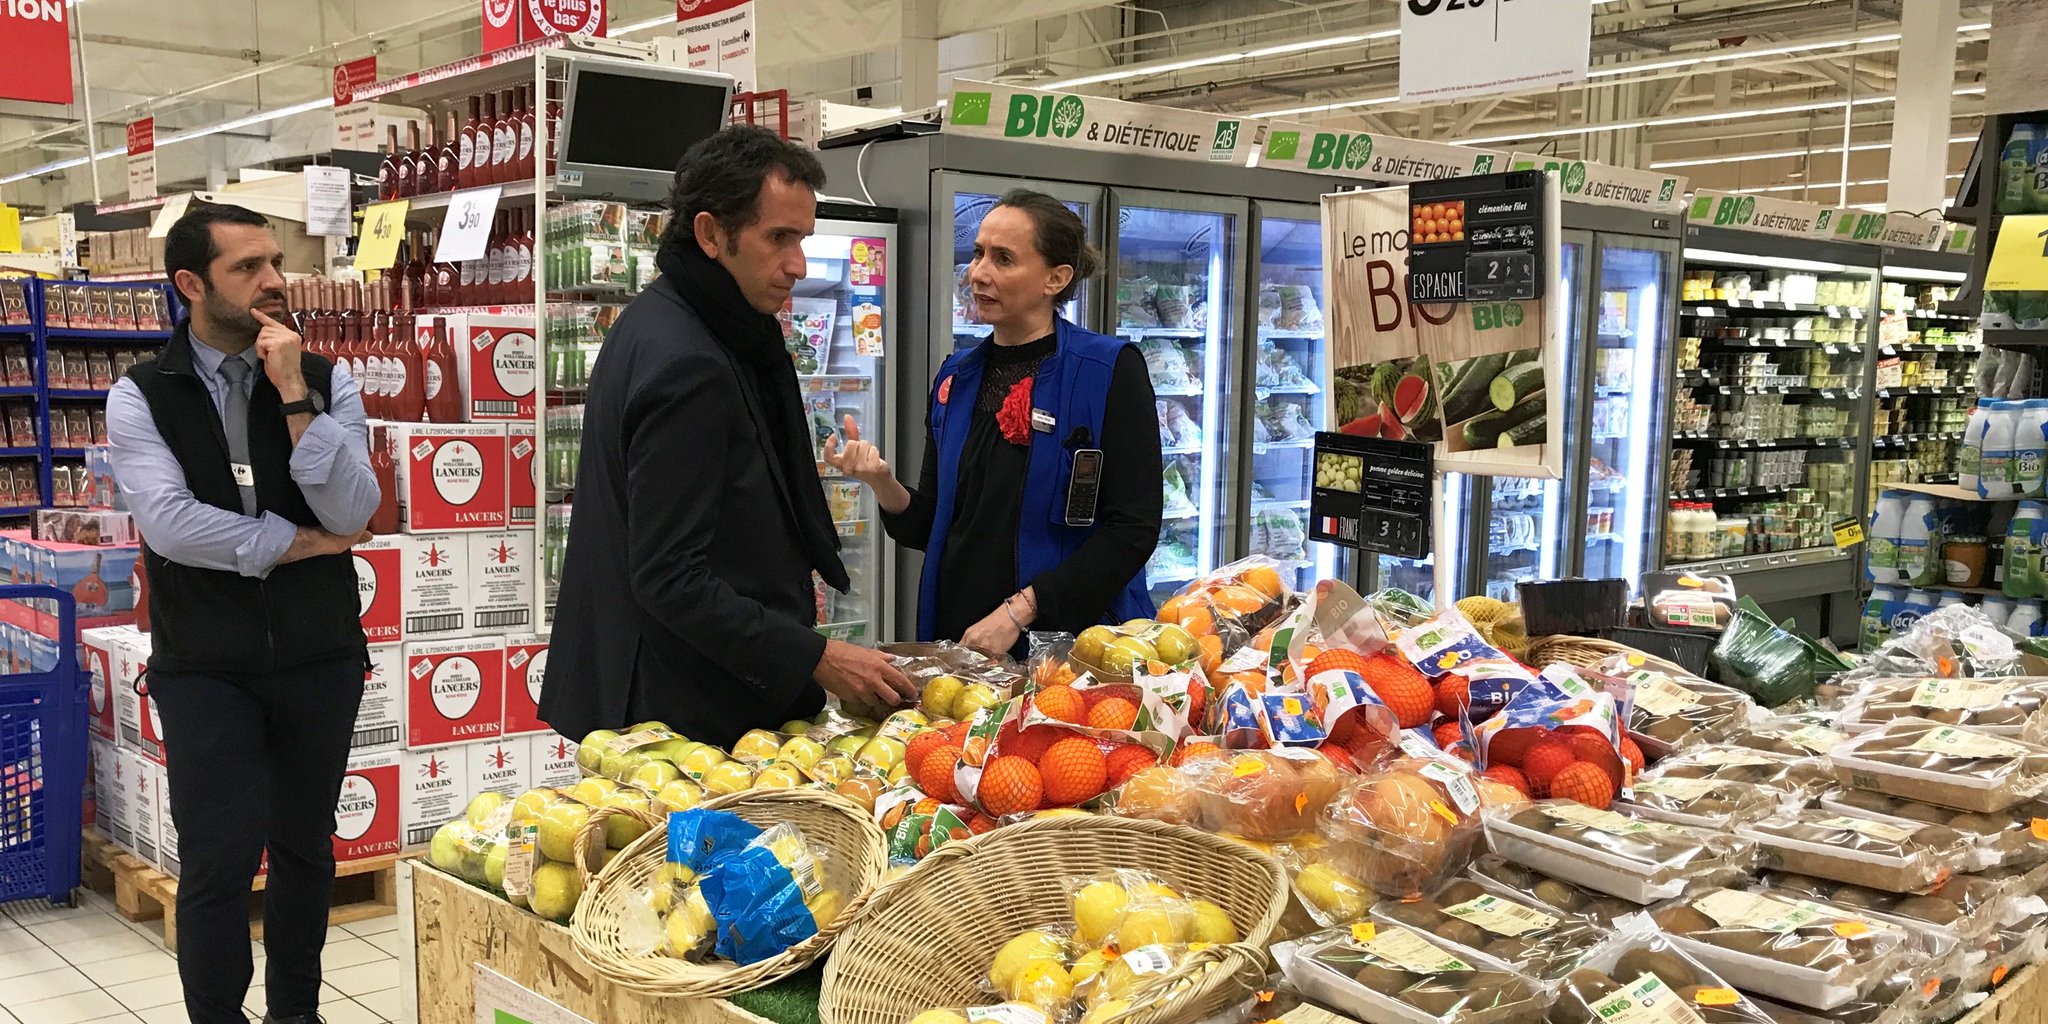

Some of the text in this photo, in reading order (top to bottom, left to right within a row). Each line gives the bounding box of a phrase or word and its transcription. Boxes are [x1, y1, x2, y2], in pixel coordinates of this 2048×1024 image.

[0, 0, 62, 22] ION
[554, 10, 578, 26] bas
[492, 36, 565, 65] PROMOTION
[418, 58, 481, 84] PROMOTION
[1004, 94, 1200, 153] BIO & DIÉTÉTIQUE
[1307, 133, 1461, 179] BIO & DIÉTÉTIQUE
[1585, 182, 1592, 196] &
[1594, 181, 1652, 204] DIÉTÉTIQUE
[1478, 202, 1527, 214] clémentine filet
[1713, 196, 1810, 232] BIO & DIÉTÉTIQUE
[1852, 214, 1887, 239] BIO
[1343, 231, 1367, 259] Le
[1487, 260, 1499, 279] 2
[1413, 271, 1464, 298] ESPAGNE
[1472, 303, 1524, 330] BIO
[496, 360, 535, 369] LANCER
[435, 467, 481, 477] LANCERS
[1387, 467, 1403, 476] golden
[2019, 458, 2040, 472] Bio
[455, 511, 504, 522] LANCERS
[1339, 516, 1359, 541] FRANCE
[1379, 520, 1389, 537] 3
[415, 568, 452, 578] LANCERS
[485, 565, 520, 574] LANCERS
[1331, 600, 1348, 618] BIO
[1891, 614, 1914, 630] lact
[364, 626, 399, 637] NCERS
[434, 681, 479, 694] LANCERS
[452, 722, 500, 735] LANCERS
[483, 768, 517, 780] LANCERS
[545, 761, 575, 771] LANCER
[415, 778, 452, 790] LANCERS
[335, 799, 375, 813] ANCERS
[348, 840, 398, 855] LANCERS
[1600, 999, 1631, 1018] BIO
